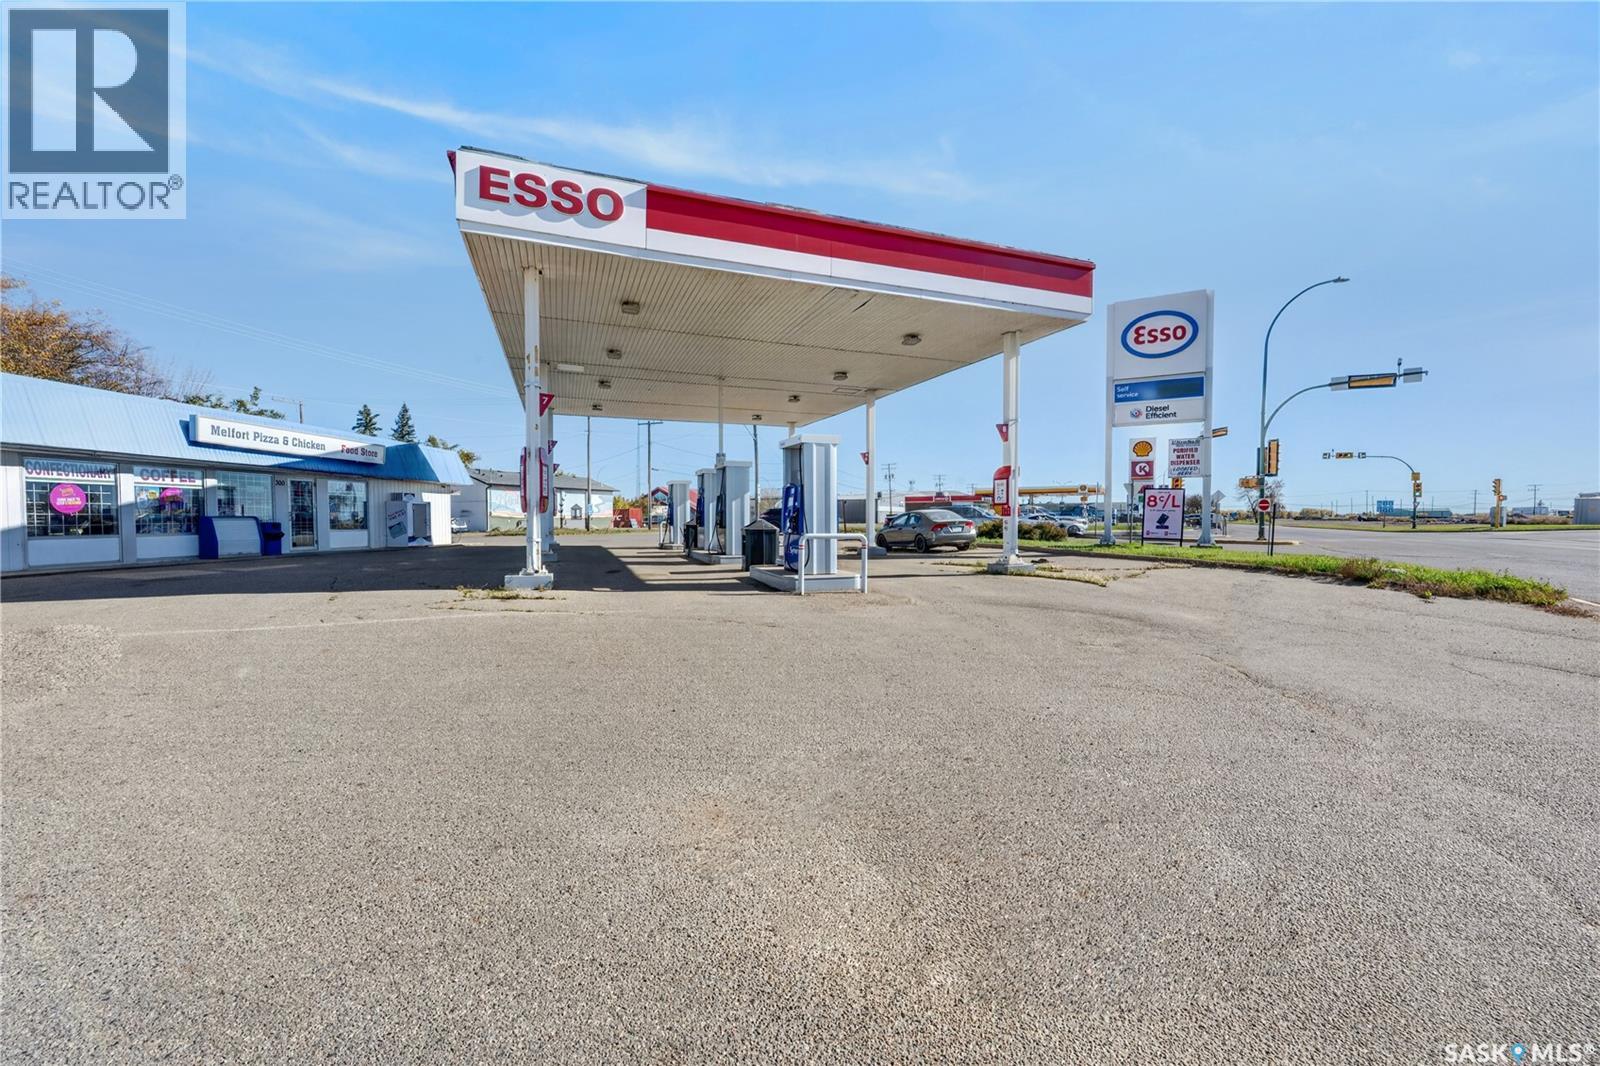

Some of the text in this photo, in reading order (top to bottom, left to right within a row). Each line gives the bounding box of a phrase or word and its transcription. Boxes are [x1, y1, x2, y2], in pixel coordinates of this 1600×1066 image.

[479, 165, 624, 222] ESSO
[1133, 325, 1187, 345] Esso
[1145, 405, 1170, 413] Diesel
[210, 424, 378, 458] Melfort Pizza & Chicken Food Store
[25, 460, 113, 479] CONFECTIONARY
[140, 468, 196, 483] COFFEE
